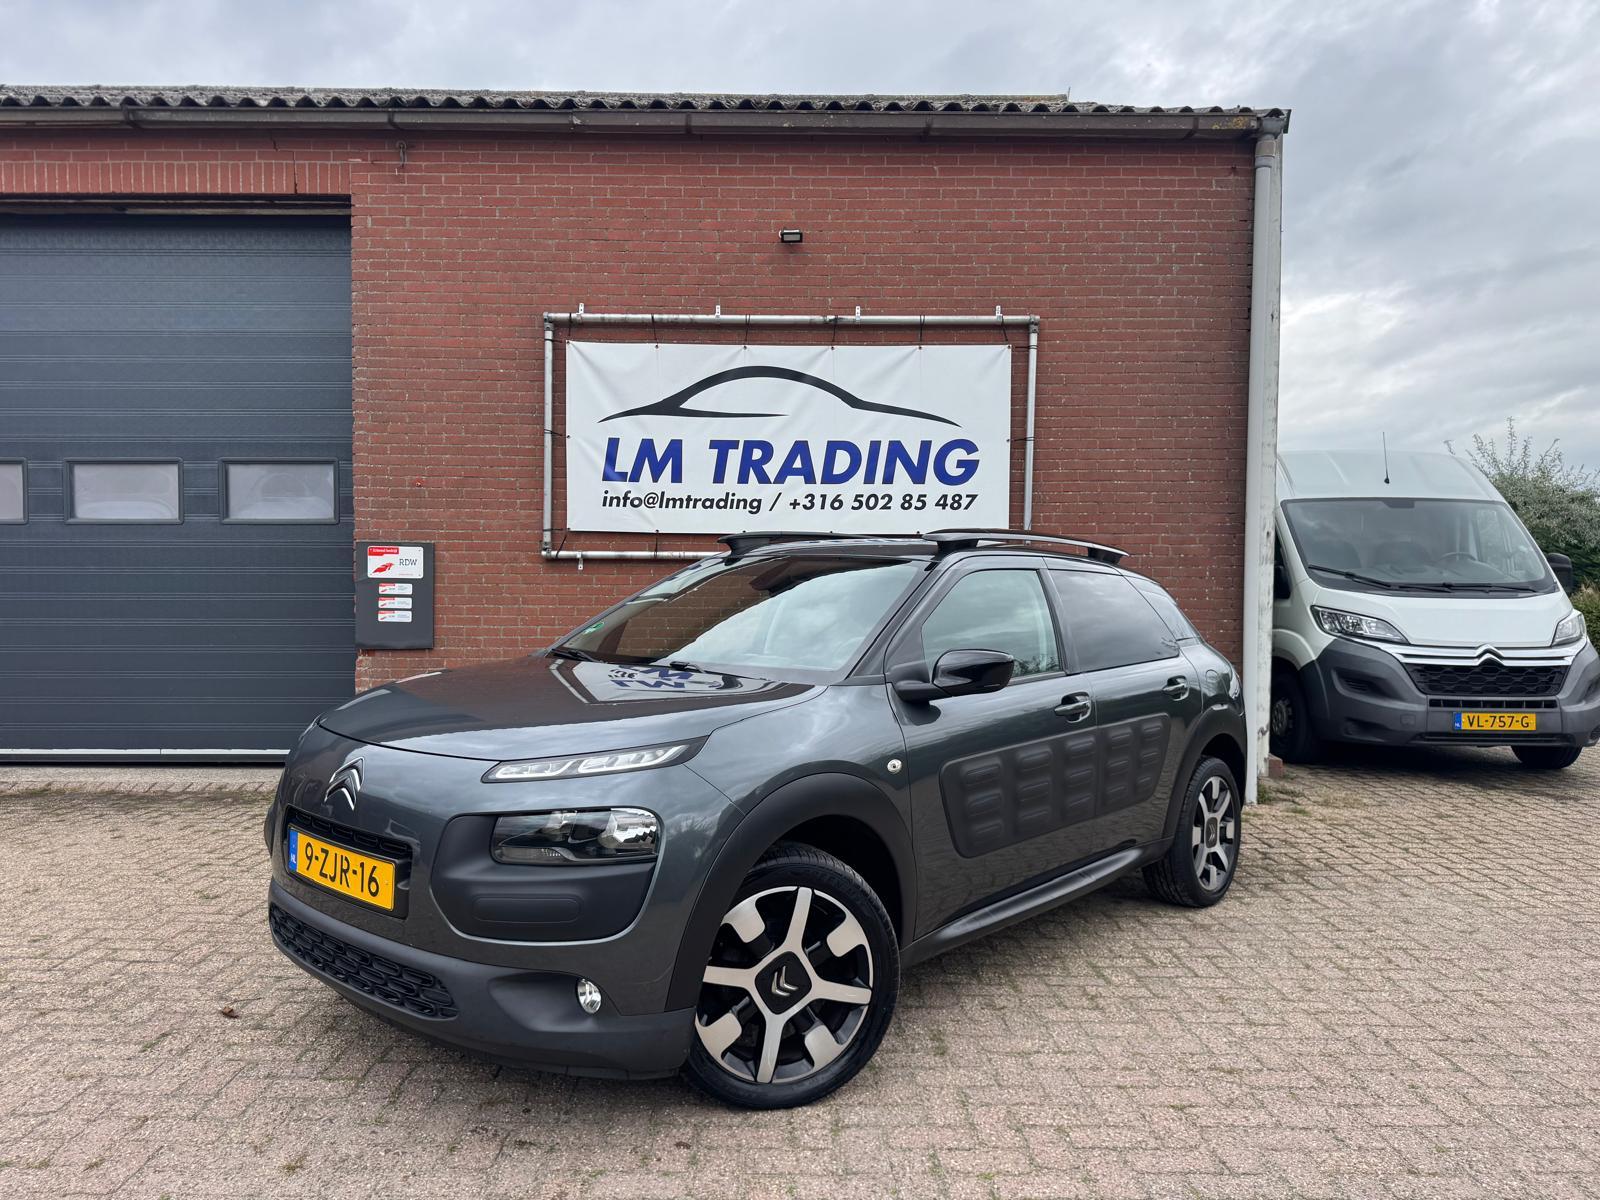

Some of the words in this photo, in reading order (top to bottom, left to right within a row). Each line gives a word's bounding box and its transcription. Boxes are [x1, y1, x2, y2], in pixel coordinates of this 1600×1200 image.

[602, 437, 683, 484] LM
[709, 438, 980, 487] TRADING
[602, 490, 763, 515] info@lmtrading
[768, 493, 783, 512] /
[789, 493, 844, 511] +316
[850, 493, 893, 511] 502
[900, 493, 927, 511] 85
[934, 493, 979, 511] 487
[399, 558, 417, 566] RDW
[1467, 715, 1529, 728] VL-757-G
[304, 842, 380, 897] 9-ZJR-16
